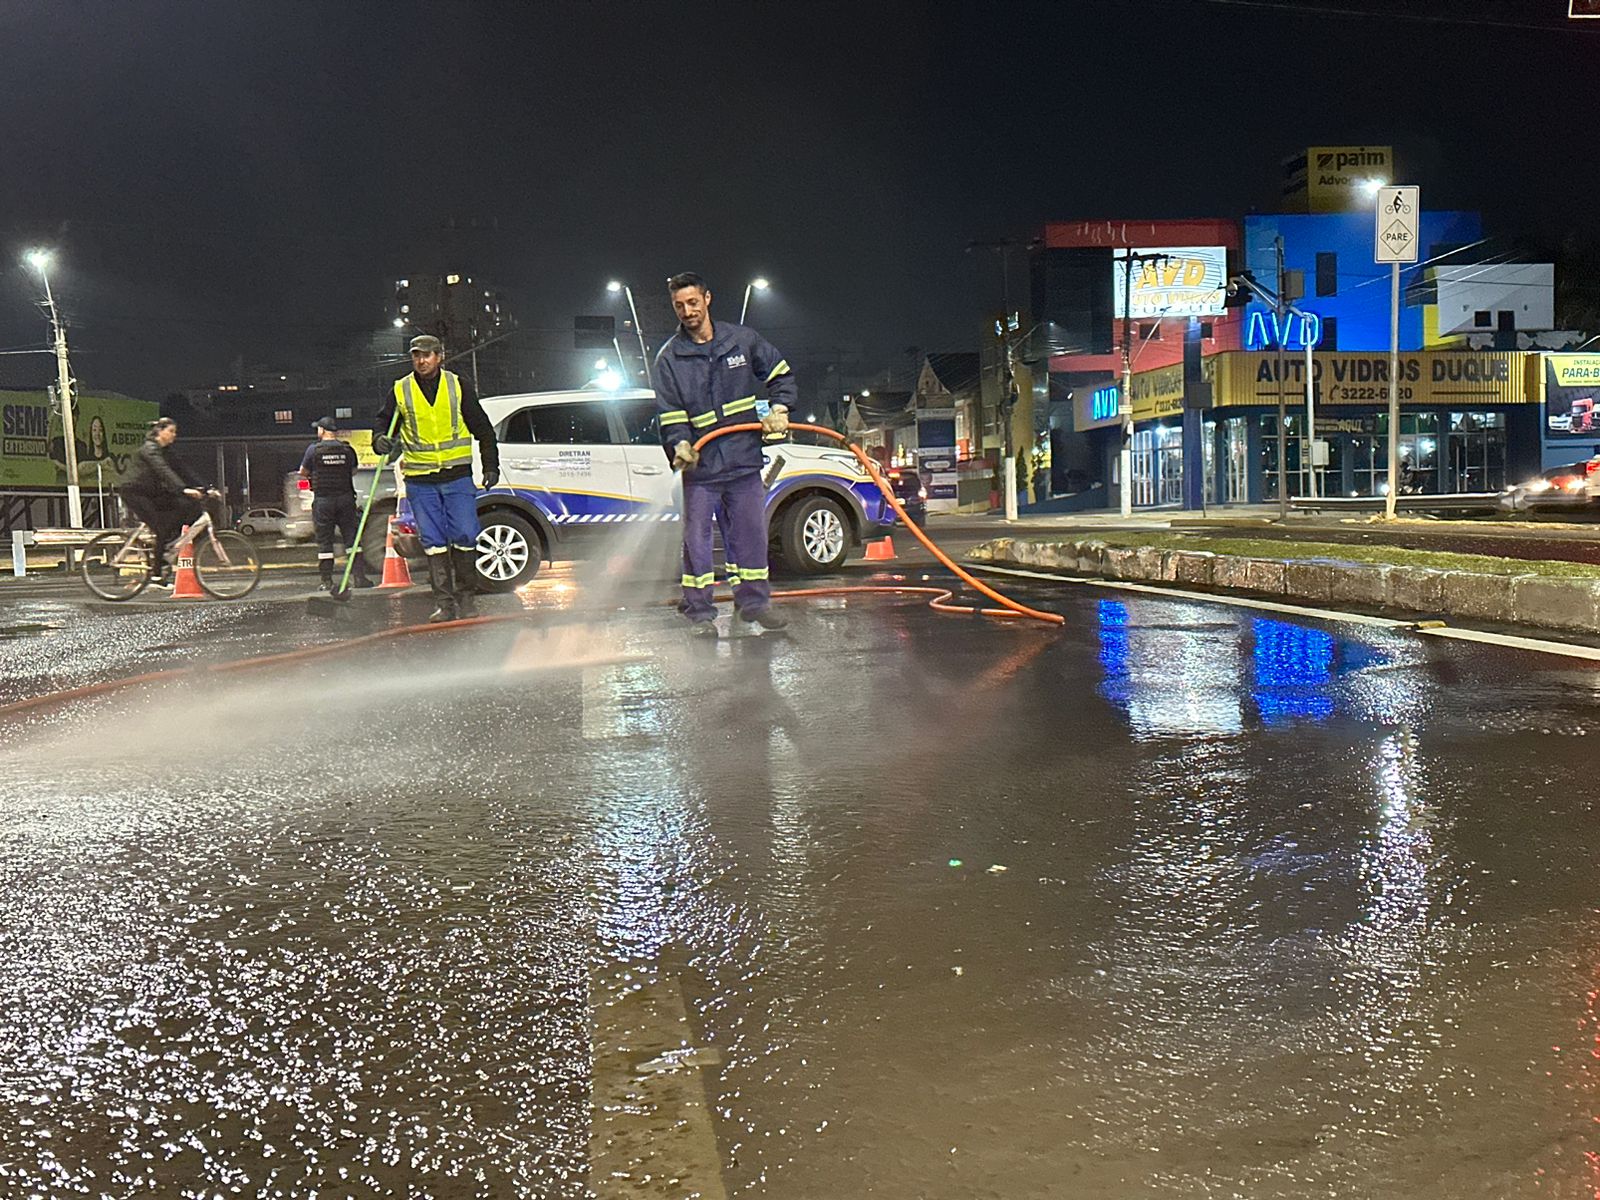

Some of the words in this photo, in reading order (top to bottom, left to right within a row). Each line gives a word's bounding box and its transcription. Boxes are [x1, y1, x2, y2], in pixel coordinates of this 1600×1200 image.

[1336, 147, 1384, 171] paim
[1386, 232, 1408, 241] PARE
[1135, 259, 1206, 289] AVD
[1248, 311, 1319, 346] AVD
[1257, 359, 1323, 382] AUTO
[1332, 359, 1420, 382] VIDROS
[1432, 359, 1509, 382] DUQUE
[1093, 387, 1118, 419] AVD
[1341, 387, 1412, 400] 3222-620
[111, 432, 146, 445] ABERT
